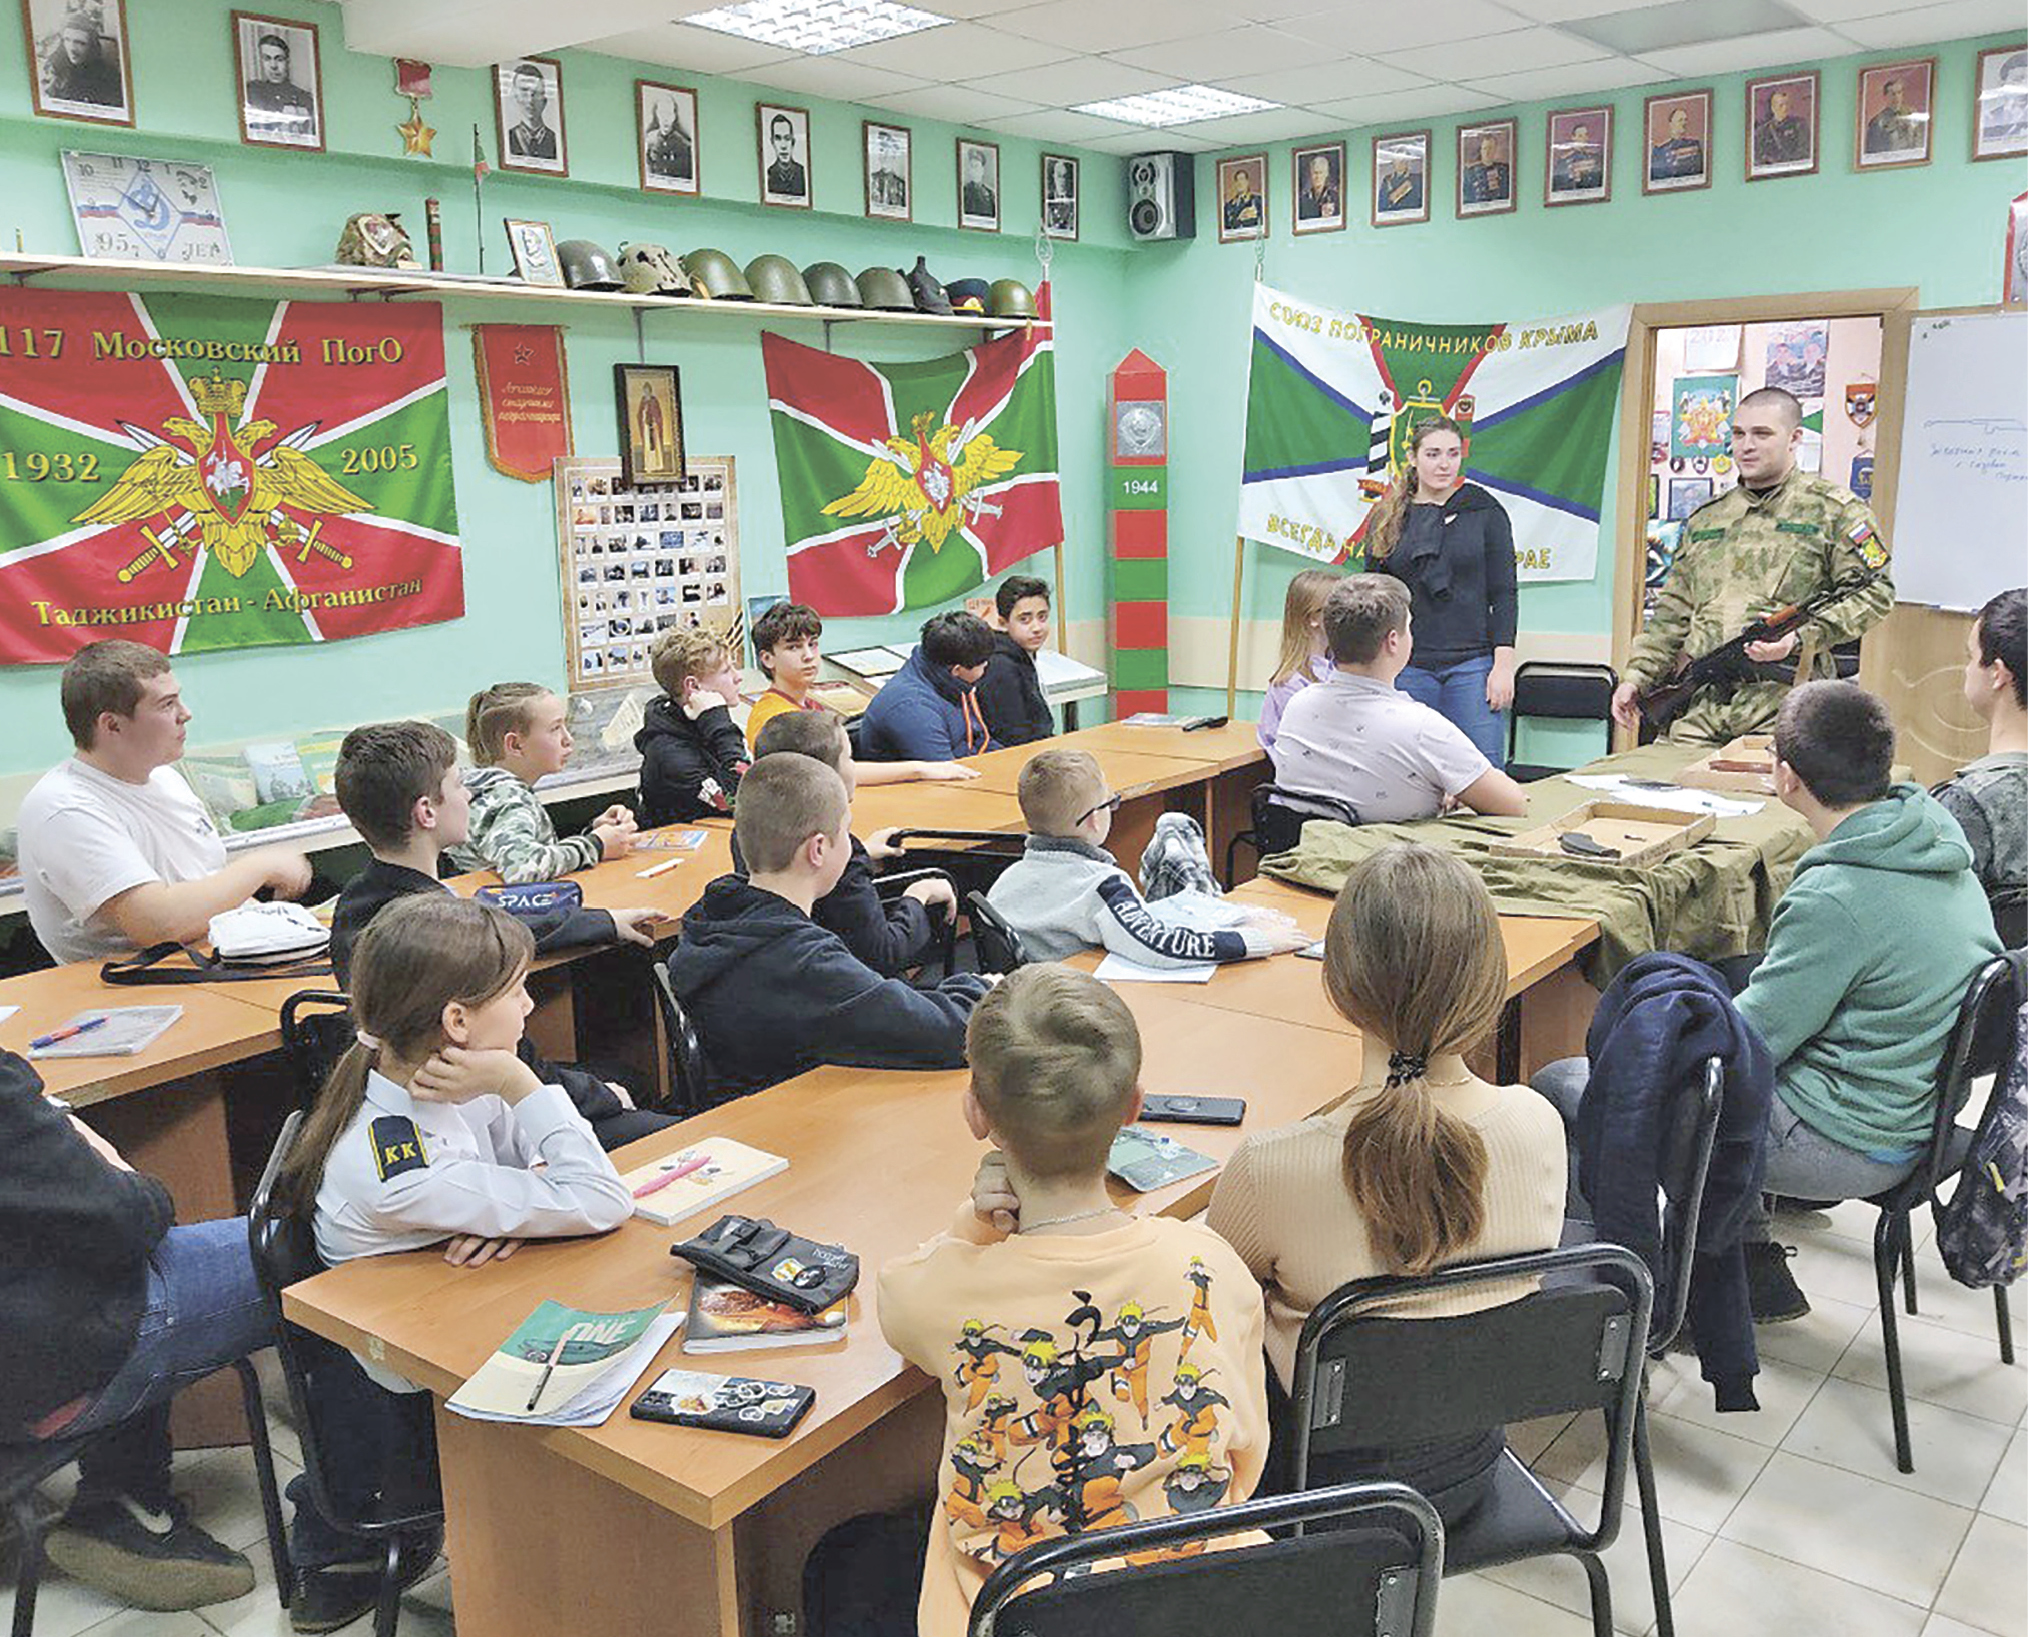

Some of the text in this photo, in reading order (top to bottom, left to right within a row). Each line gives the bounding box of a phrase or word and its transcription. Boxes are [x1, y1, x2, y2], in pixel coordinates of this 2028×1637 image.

[136, 159, 151, 173] 12
[1269, 302, 1599, 354] СОЮЗ ПОГРАНИЧНИКОВ КРЫМА
[0, 325, 404, 365] 117 Московский ПогО
[1, 452, 101, 483] 1932
[341, 444, 419, 475] 2005
[1123, 480, 1158, 495] 1944
[1267, 513, 1336, 554] ВСЕГДА
[1514, 547, 1551, 569] РАЕ
[31, 597, 242, 628] Таджикистан
[263, 578, 423, 615] Афганистан
[498, 893, 553, 907] SPACE
[573, 1319, 637, 1345] ONE
